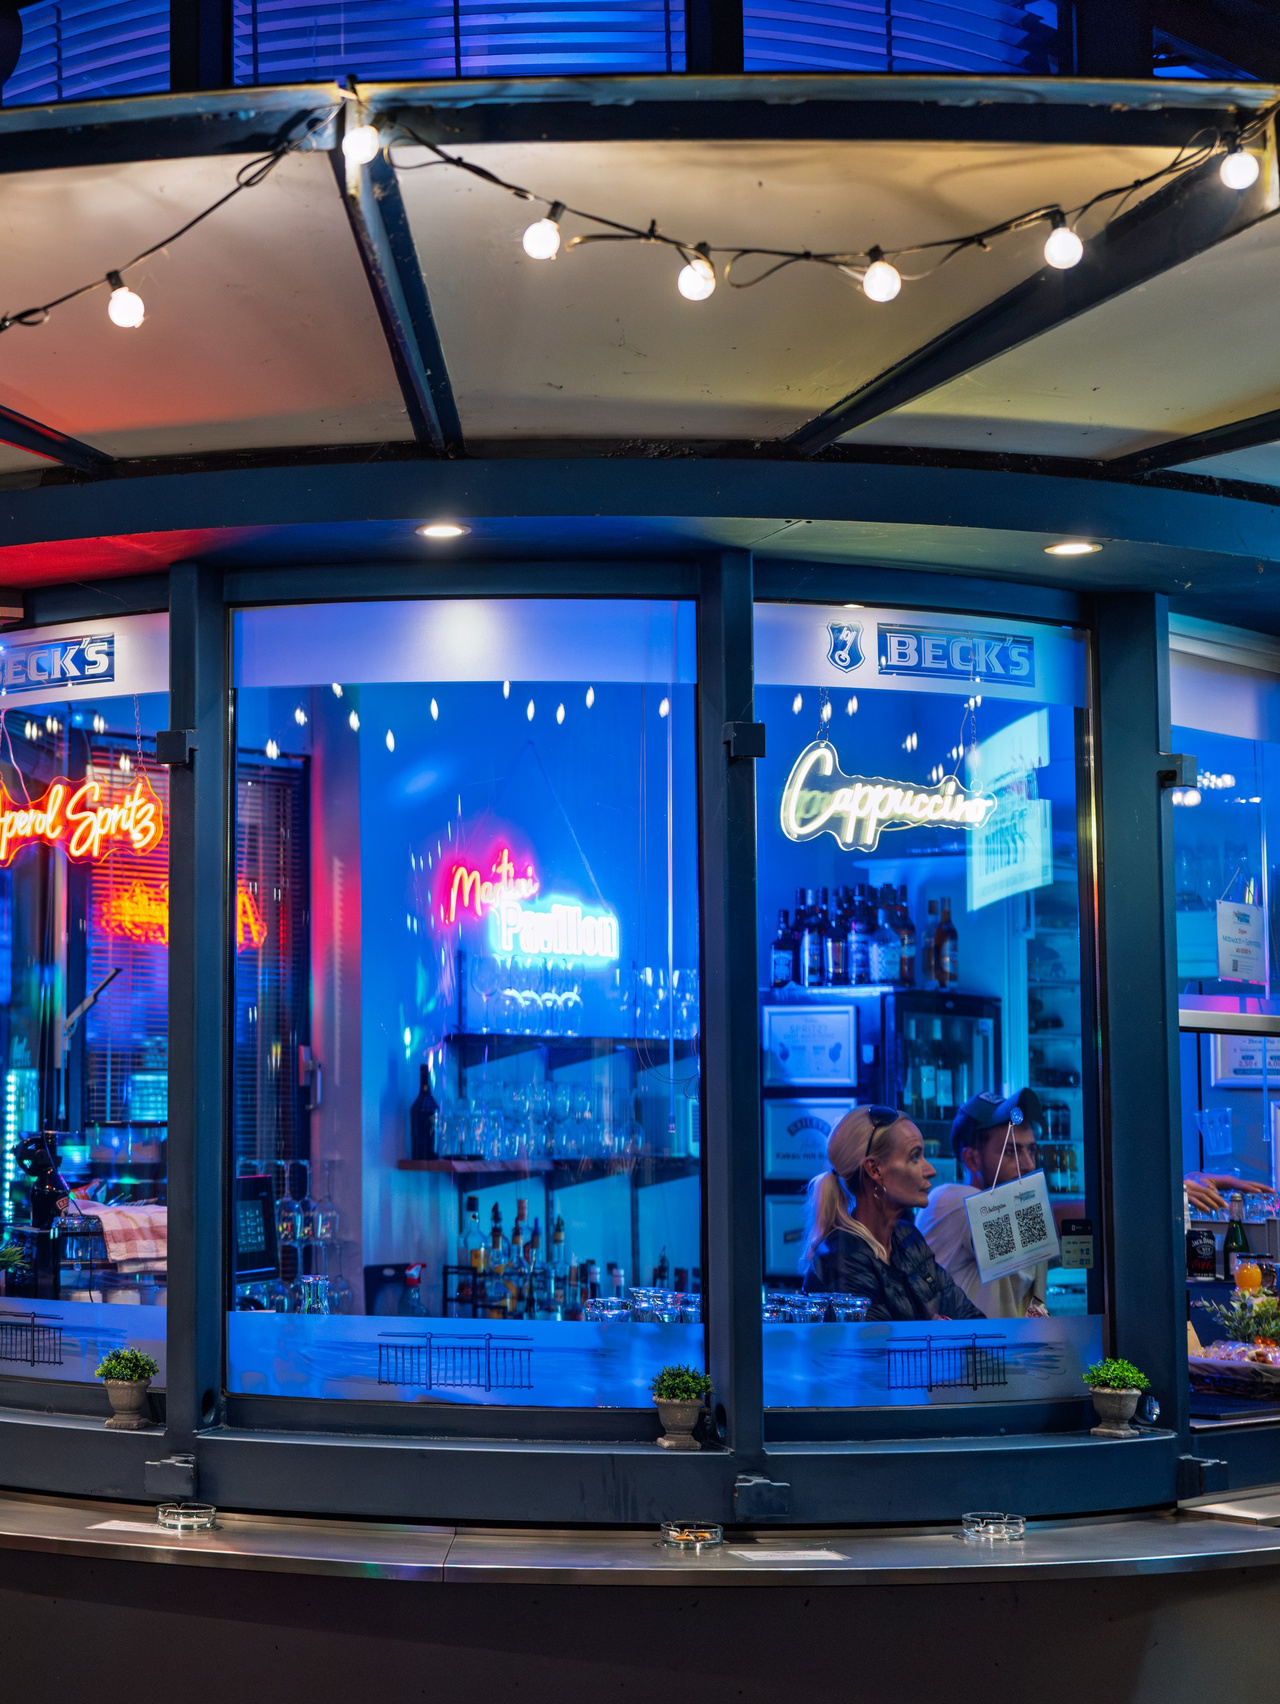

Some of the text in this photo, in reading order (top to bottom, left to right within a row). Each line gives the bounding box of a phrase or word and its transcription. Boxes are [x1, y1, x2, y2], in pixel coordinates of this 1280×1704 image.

[886, 632, 1030, 676] BECK'S
[66, 781, 156, 857] Spritz
[789, 748, 994, 844] Cappuccino
[449, 848, 539, 922] Martini
